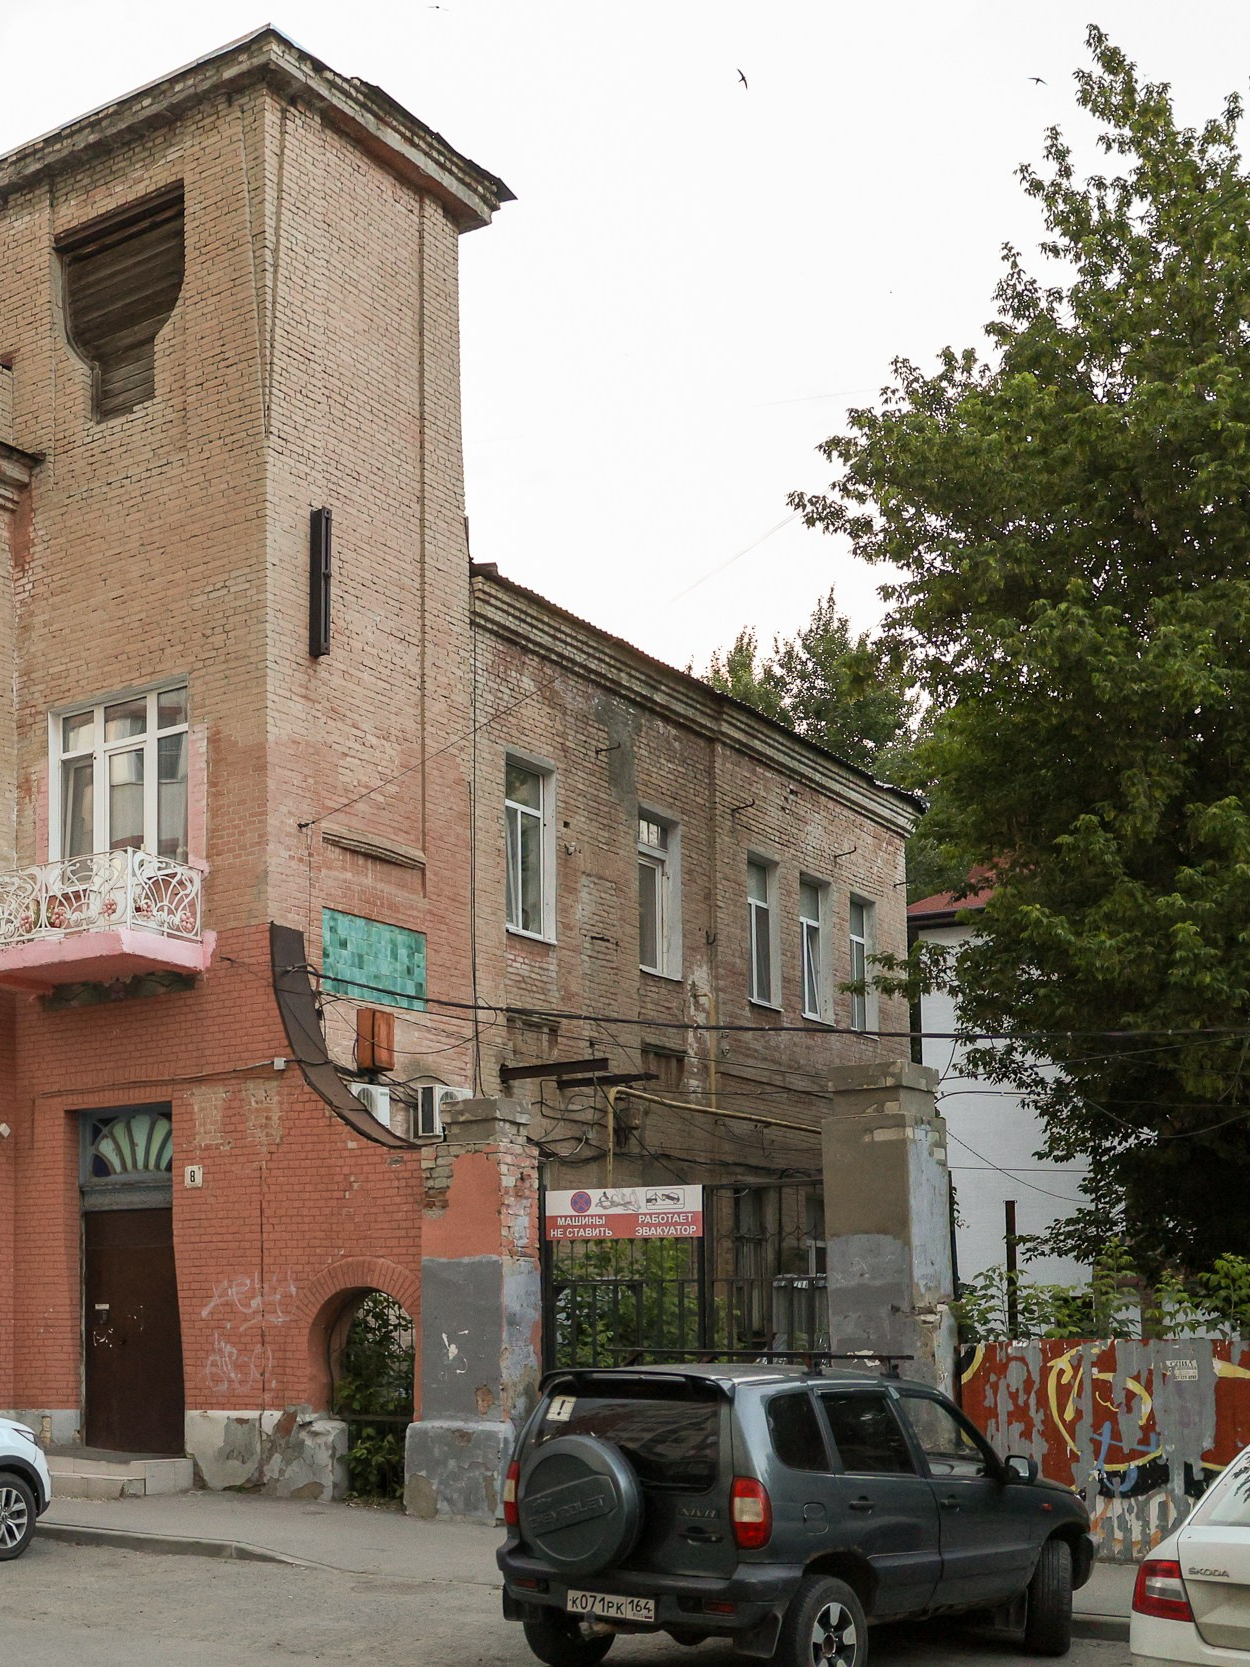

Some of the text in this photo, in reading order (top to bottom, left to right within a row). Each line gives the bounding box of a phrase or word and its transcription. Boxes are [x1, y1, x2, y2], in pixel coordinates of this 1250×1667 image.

[190, 1170, 195, 1182] 8
[557, 1215, 606, 1226] МАШИНЫ
[638, 1213, 693, 1224] РАБОТАЕТ
[550, 1227, 613, 1237] НЕ СТАВИТЬ
[635, 1225, 697, 1236] ЭВАКУАТОР
[628, 1599, 652, 1613] 164
